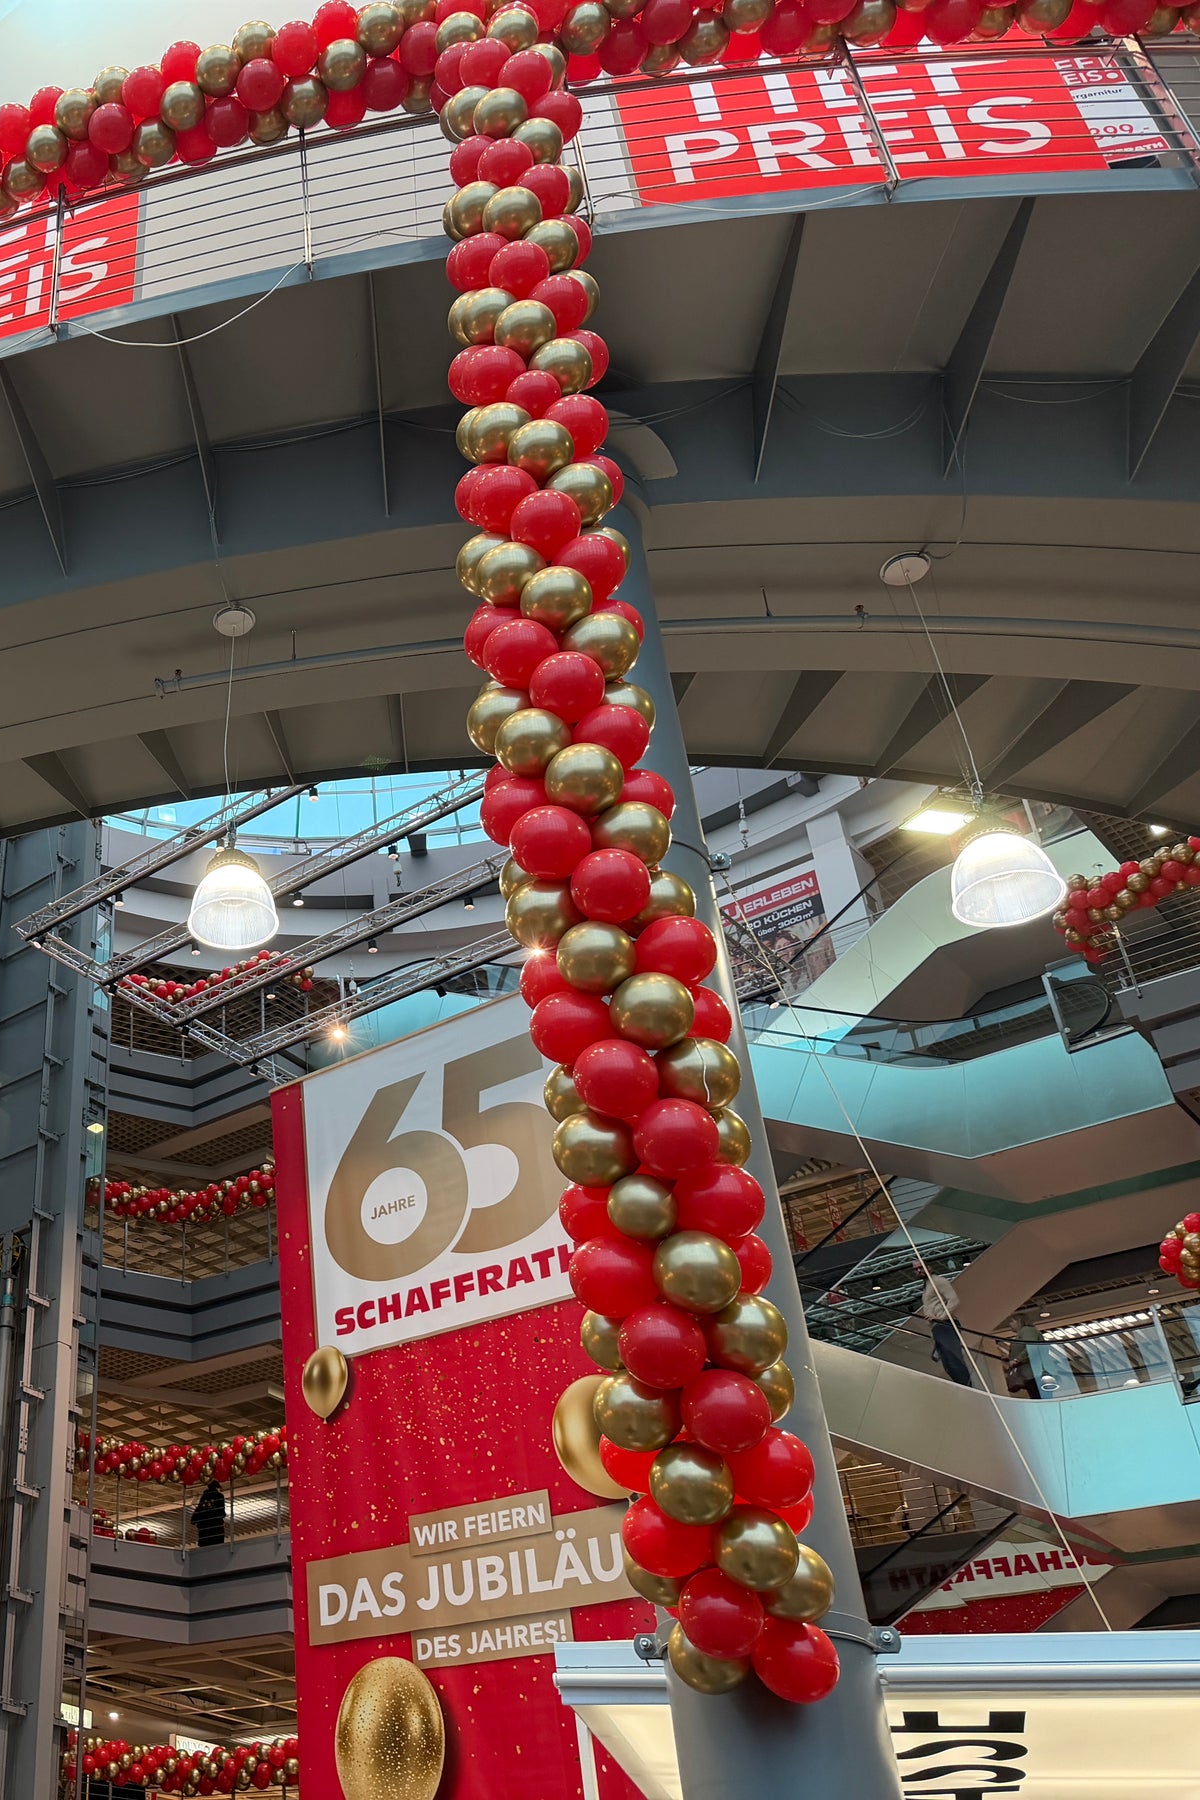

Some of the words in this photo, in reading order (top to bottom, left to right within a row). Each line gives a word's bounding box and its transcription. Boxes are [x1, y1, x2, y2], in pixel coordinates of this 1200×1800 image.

[664, 96, 1052, 184] PREIS
[743, 877, 814, 914] ERLEBEN
[763, 899, 813, 925] KÜCHEN
[757, 925, 776, 937] über
[778, 914, 803, 929] 3000
[325, 1031, 569, 1282] 65
[370, 1195, 416, 1220] JAHRE
[413, 1522, 459, 1547] WIR
[463, 1503, 546, 1538] FEIERN
[318, 1572, 407, 1626] DAS
[416, 1528, 625, 1611] JUBILÄU
[416, 1634, 461, 1661] DES
[466, 1619, 568, 1655] JAHRES!
